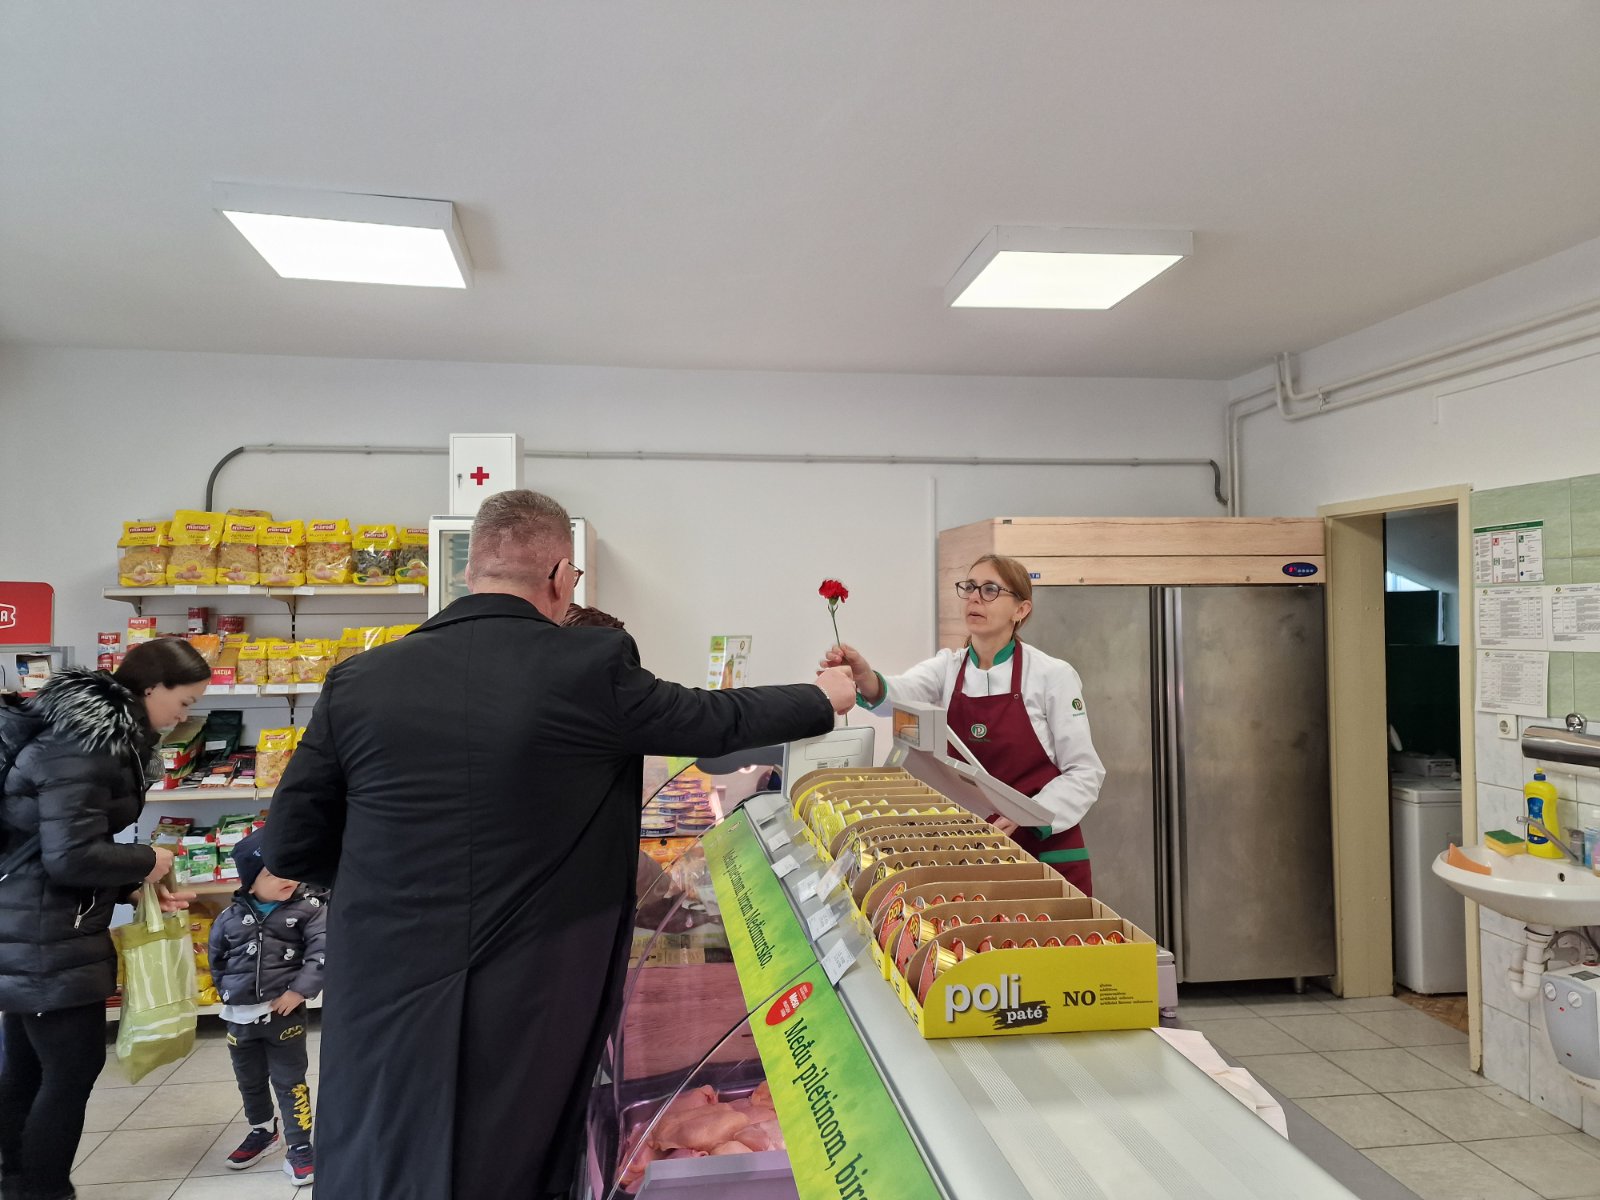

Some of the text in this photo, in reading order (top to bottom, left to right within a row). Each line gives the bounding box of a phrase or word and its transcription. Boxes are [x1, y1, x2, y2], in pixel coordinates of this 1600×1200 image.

[745, 908, 775, 969] Međimursko.
[945, 974, 1020, 1022] poli
[1006, 1006, 1043, 1024] paté
[1063, 990, 1096, 1007] NO
[784, 1017, 869, 1200] Među piletinom, bir
